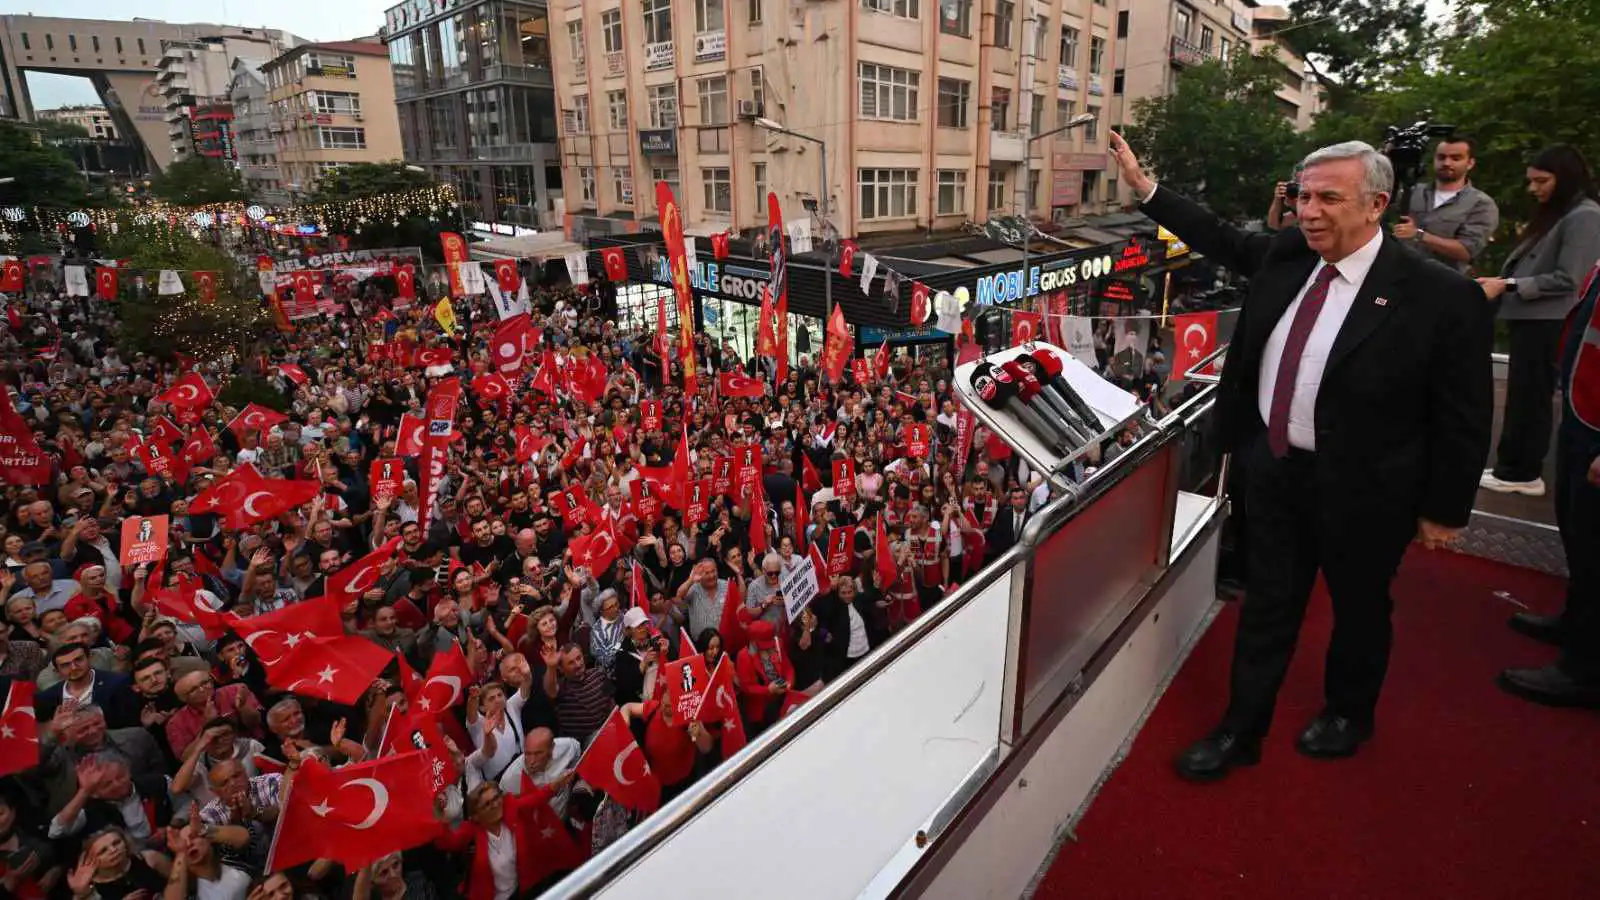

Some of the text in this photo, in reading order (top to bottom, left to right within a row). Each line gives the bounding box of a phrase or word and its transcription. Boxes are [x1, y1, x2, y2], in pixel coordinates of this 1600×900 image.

[653, 43, 674, 53] AVUKA
[976, 266, 1076, 306] MOBIE GROSS
[431, 422, 450, 433] CHP
